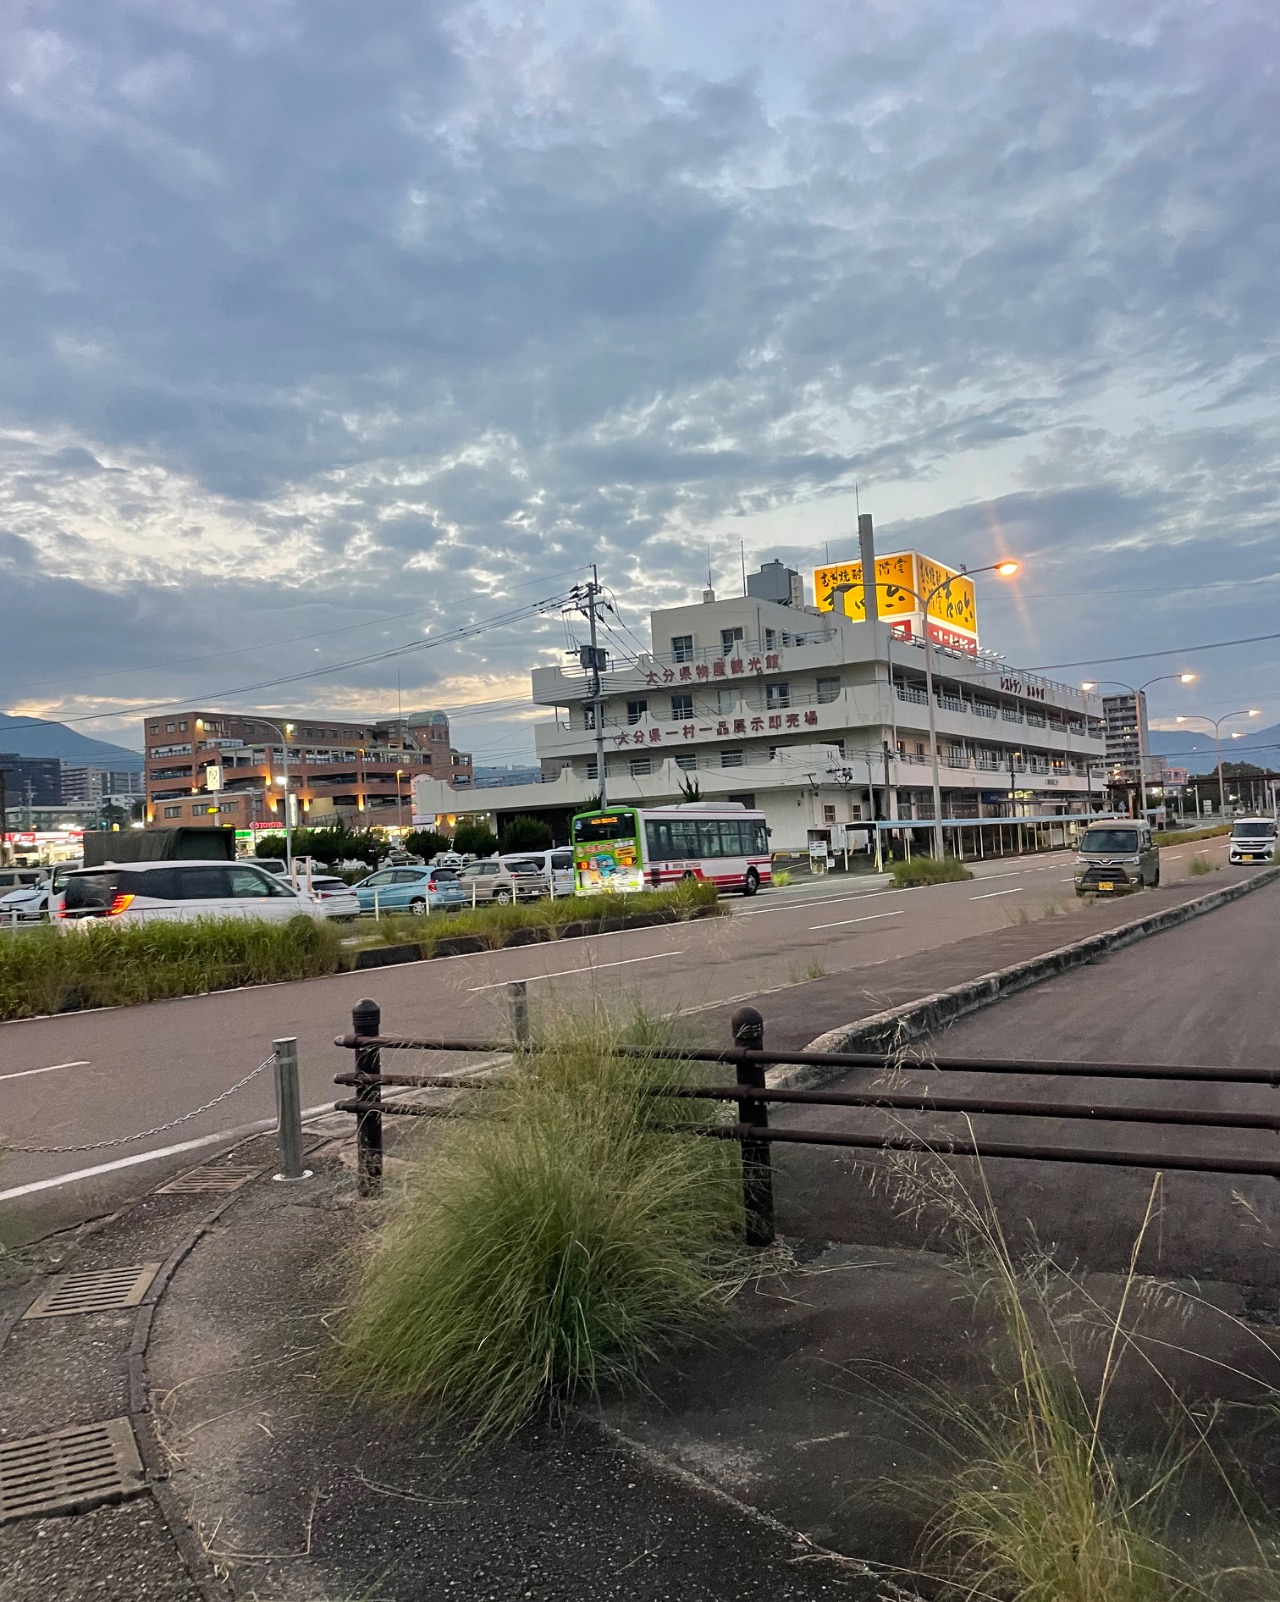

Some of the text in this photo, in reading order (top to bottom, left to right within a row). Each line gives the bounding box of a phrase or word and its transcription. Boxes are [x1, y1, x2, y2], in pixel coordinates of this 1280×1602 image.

[645, 653, 780, 685] 大分県物産観光館
[617, 710, 819, 746] 大分県一村一品展示即売場
